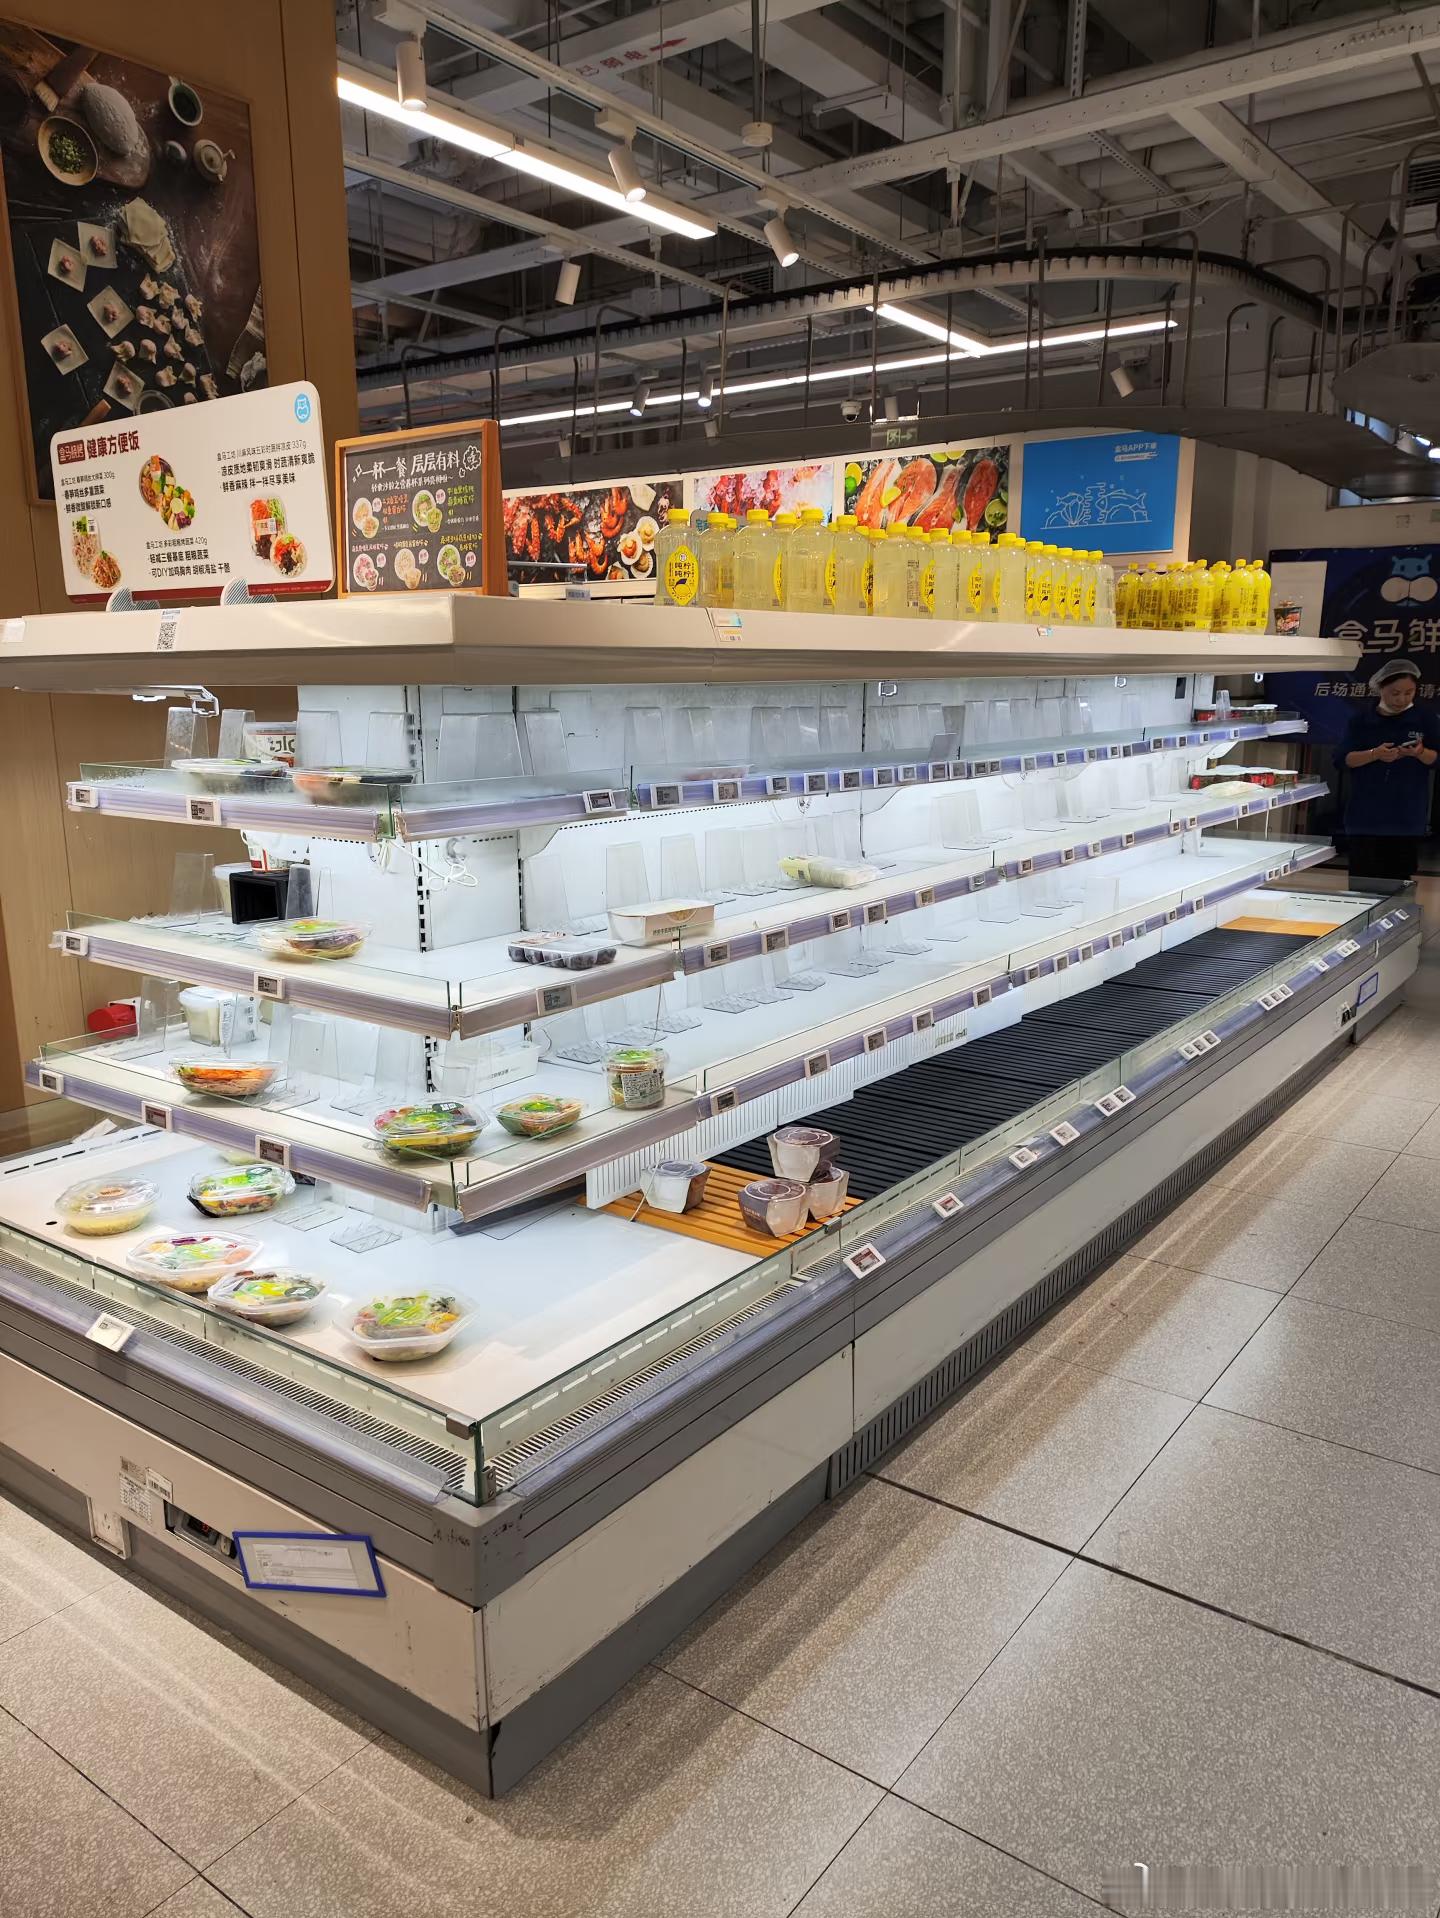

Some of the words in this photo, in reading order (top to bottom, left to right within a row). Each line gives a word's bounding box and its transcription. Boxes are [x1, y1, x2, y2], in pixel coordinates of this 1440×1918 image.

[87, 430, 140, 459] 健康方便饭
[362, 456, 407, 480] 一杯一餐
[410, 450, 460, 476] 层层有料
[222, 478, 248, 492] 鲜香麻辣
[249, 472, 296, 488] 拌一拌尽享美味
